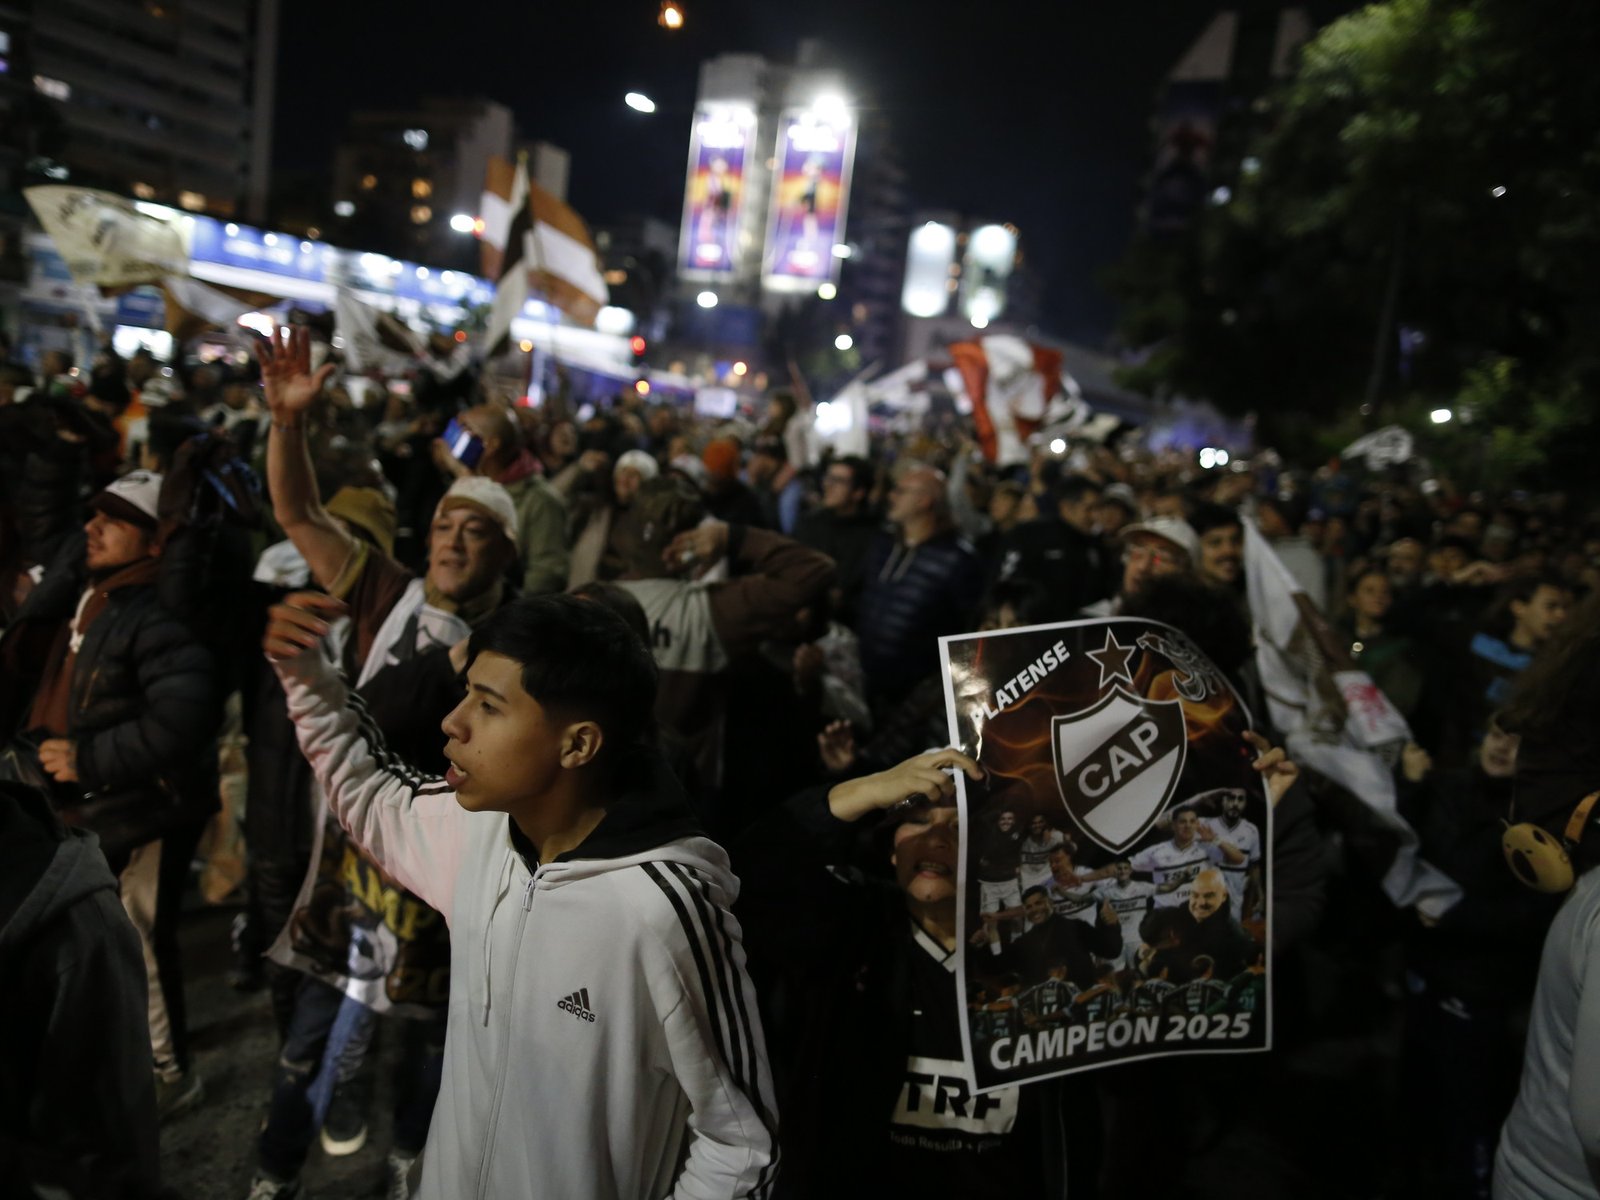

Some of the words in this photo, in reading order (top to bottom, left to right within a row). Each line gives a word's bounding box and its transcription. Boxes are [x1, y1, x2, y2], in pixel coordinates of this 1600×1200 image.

[970, 639, 1071, 726] PLATENSE
[1077, 720, 1160, 799] CAP
[557, 1000, 596, 1023] adidas
[989, 1012, 1160, 1071] CAMPEÓN
[1164, 1011, 1252, 1042] 2025
